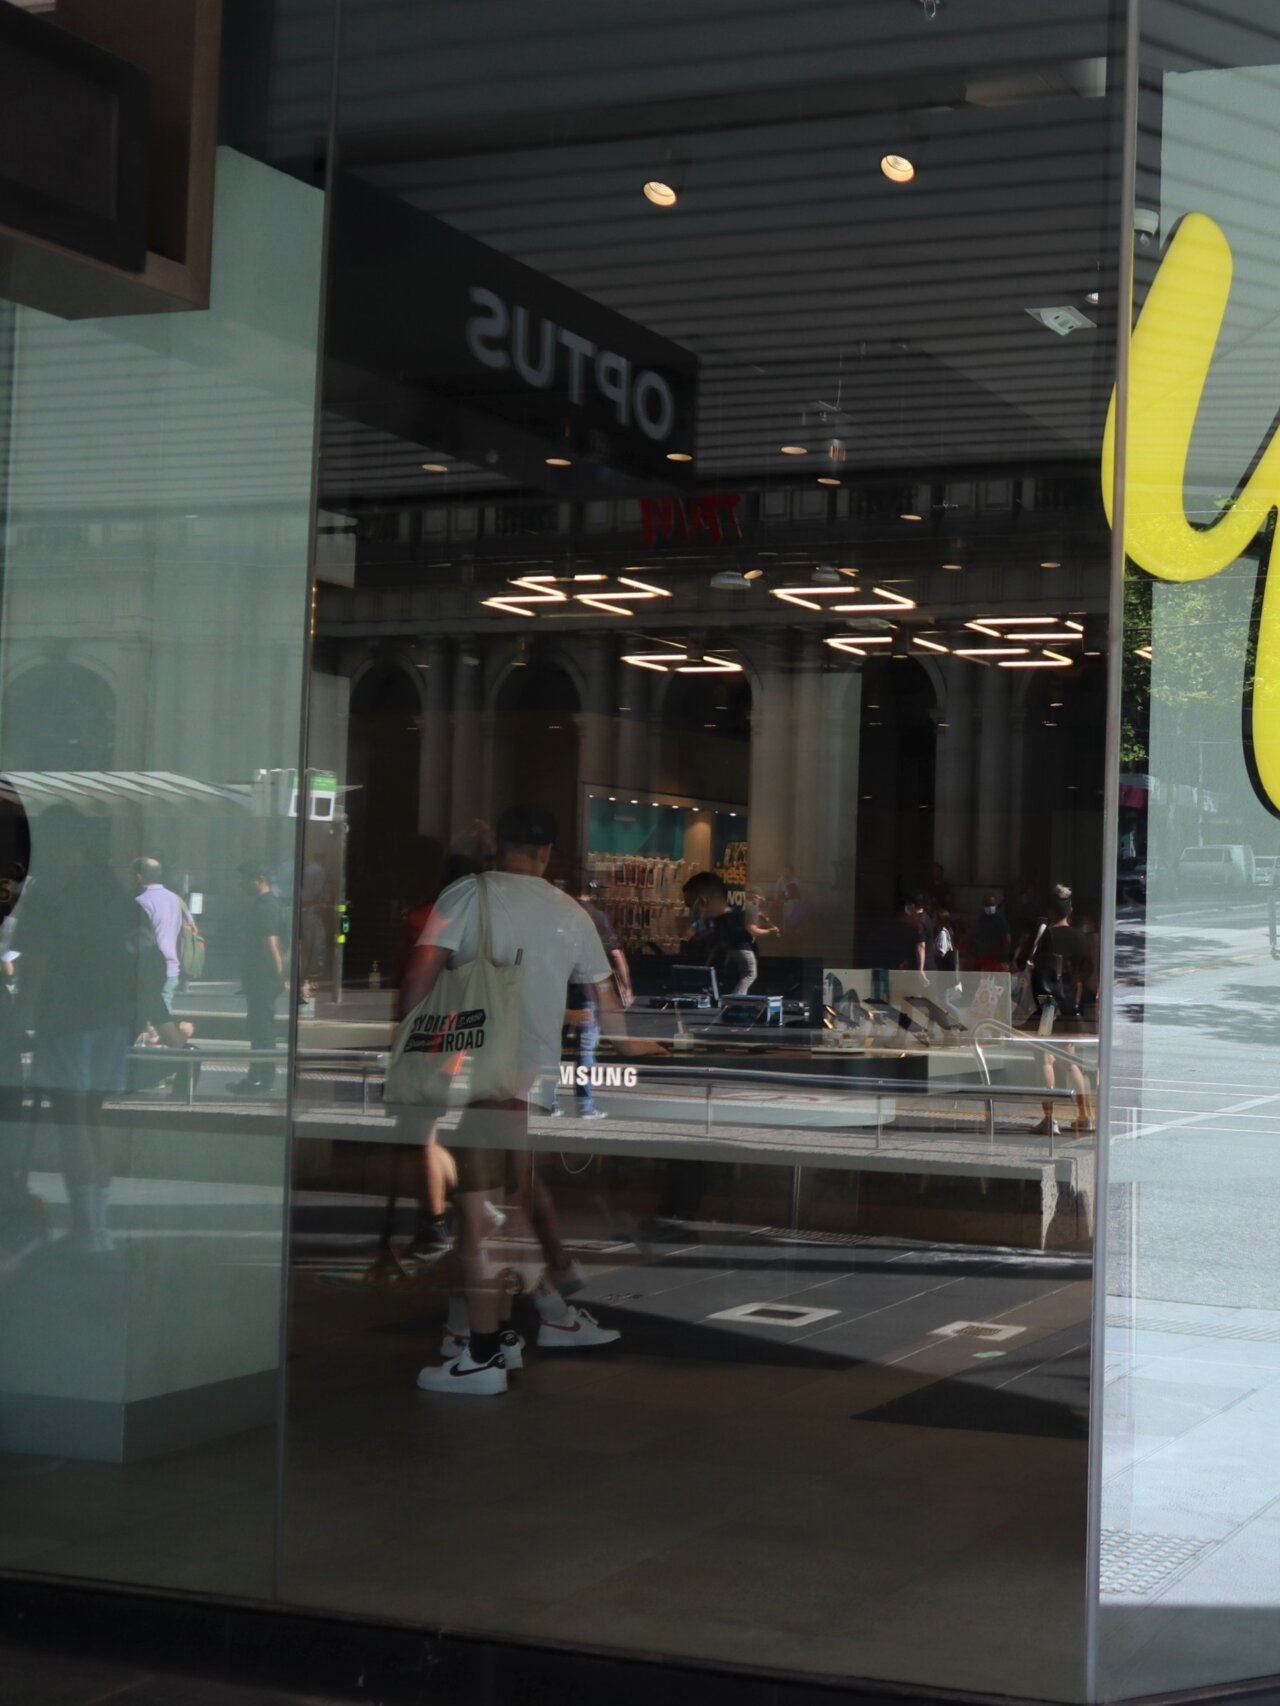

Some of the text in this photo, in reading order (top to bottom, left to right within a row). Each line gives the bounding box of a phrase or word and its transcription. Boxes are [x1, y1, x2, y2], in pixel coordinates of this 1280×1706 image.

[411, 1013, 458, 1034] SYDNEY
[445, 1029, 485, 1052] ROAD
[558, 1065, 638, 1088] MSUNG
